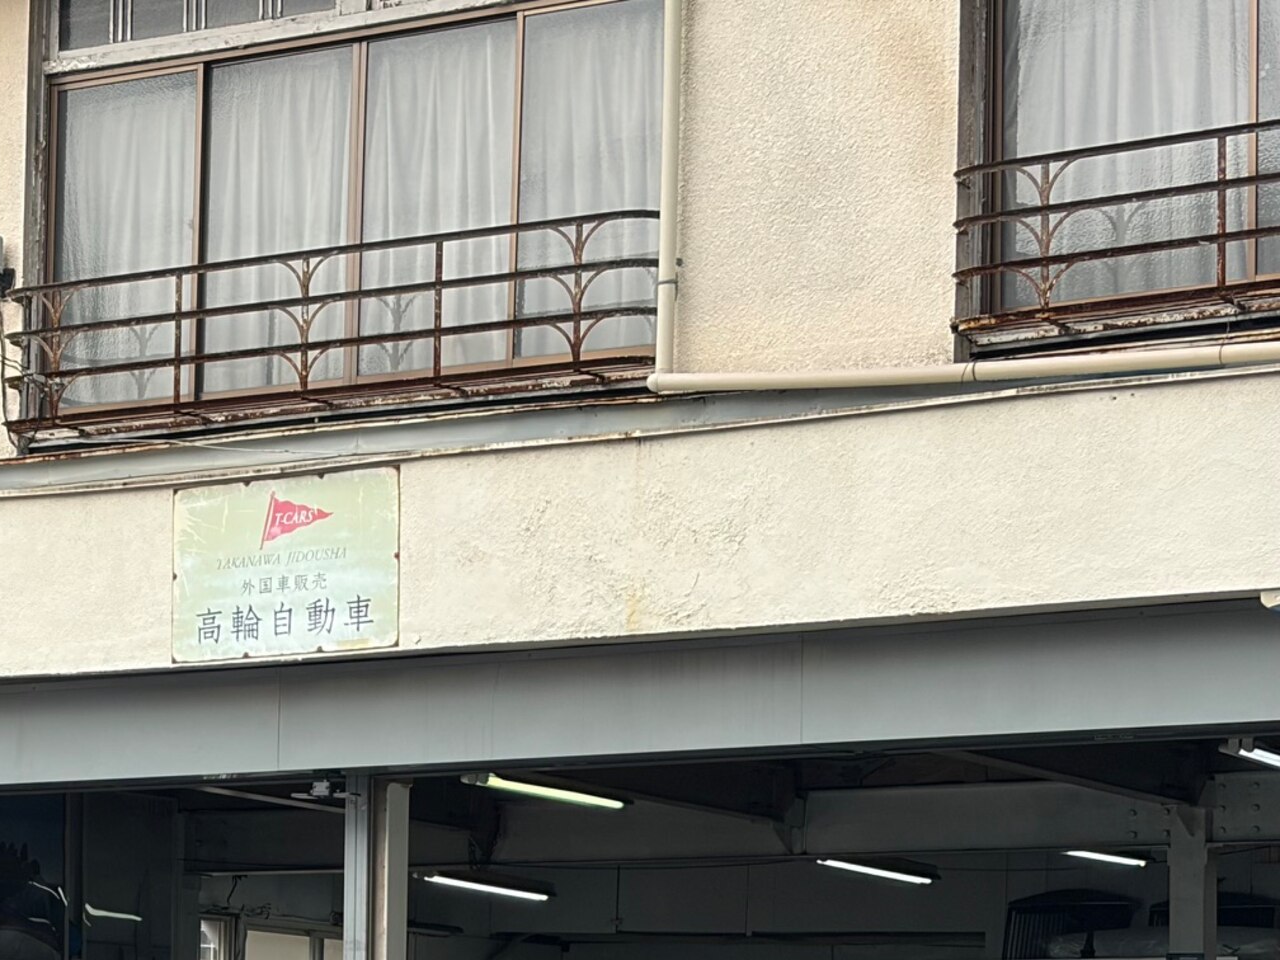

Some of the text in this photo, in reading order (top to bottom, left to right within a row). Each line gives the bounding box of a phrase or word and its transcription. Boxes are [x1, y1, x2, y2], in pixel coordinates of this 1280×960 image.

[217, 547, 347, 570] TAKANAWA JIDOUSHA
[242, 573, 327, 595] 外国車販売
[196, 595, 374, 644] 高輪自動車
